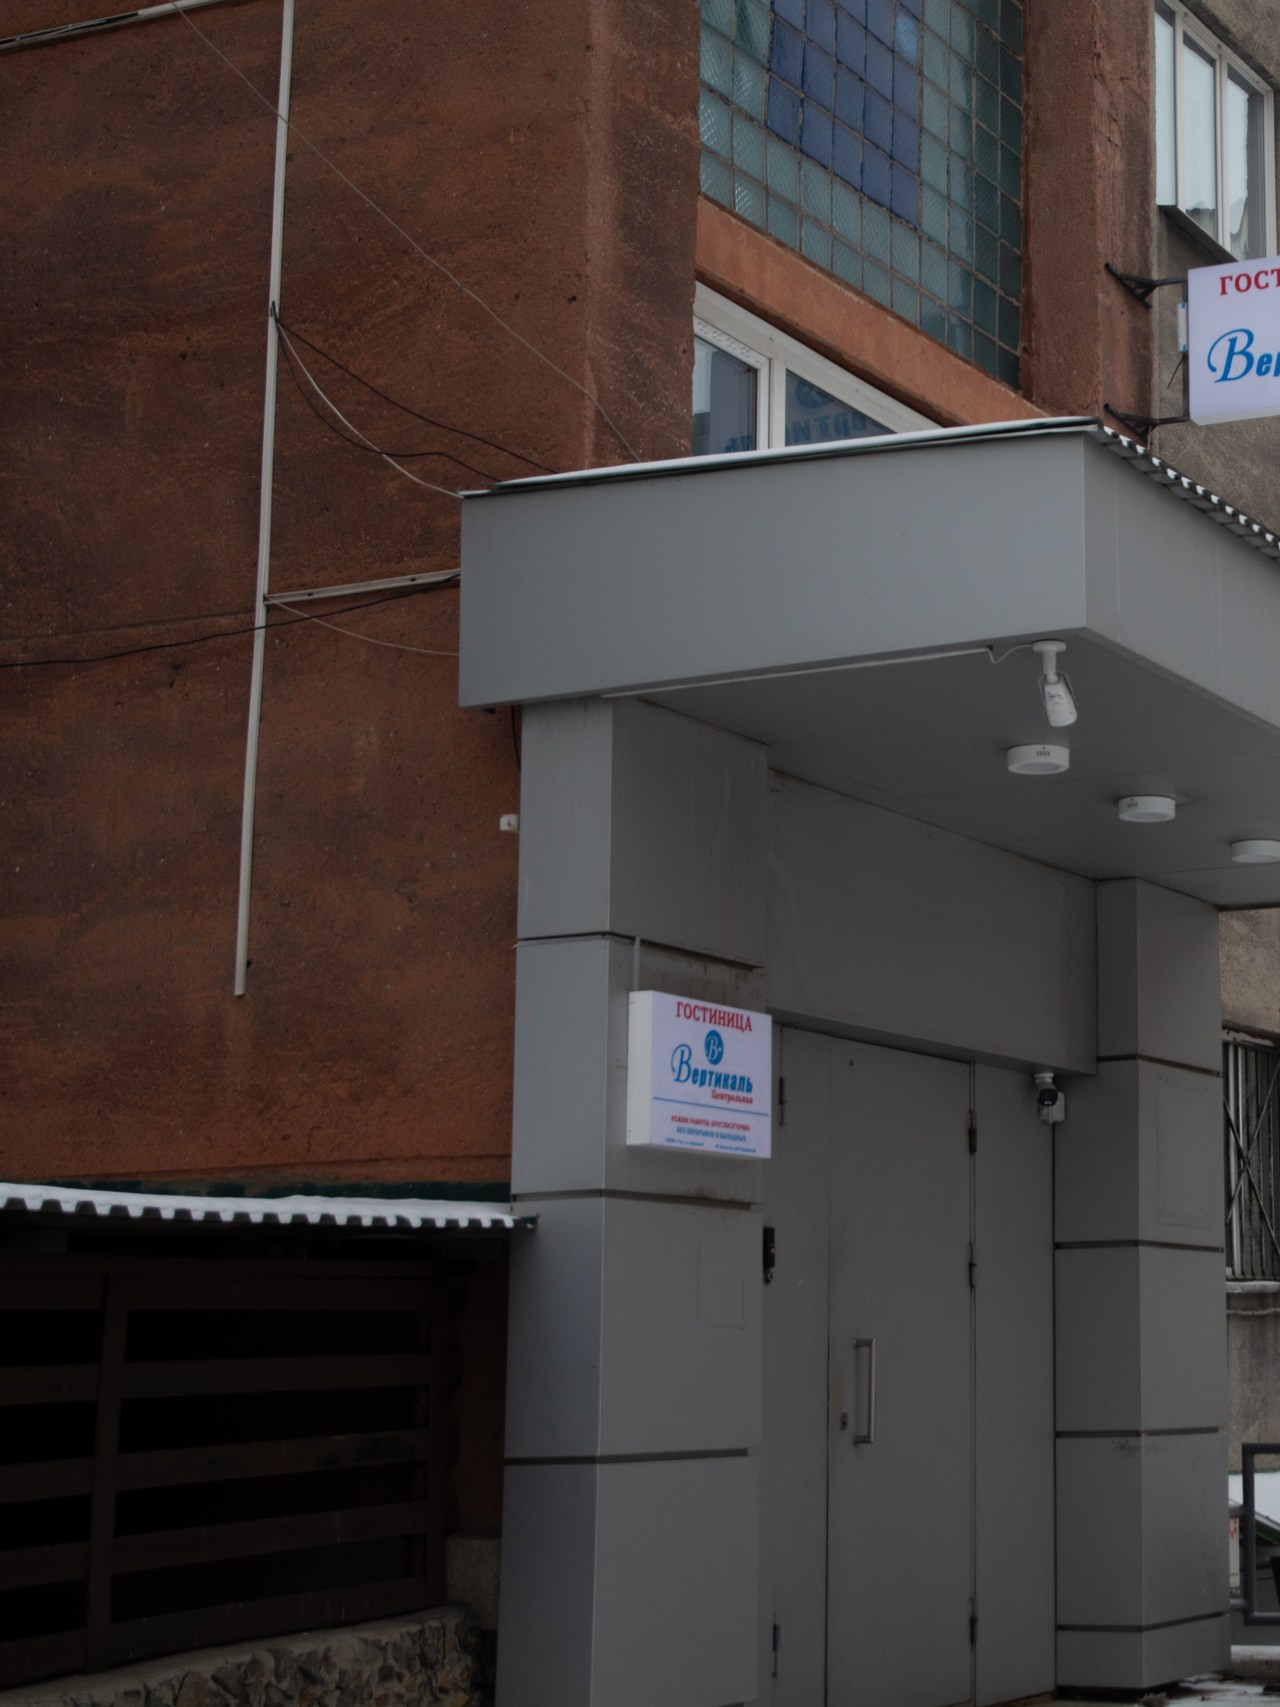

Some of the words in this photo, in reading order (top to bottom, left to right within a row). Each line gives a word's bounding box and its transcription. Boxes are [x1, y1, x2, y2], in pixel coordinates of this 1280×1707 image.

[675, 1001, 753, 1032] ГОСТИНИЦА
[671, 1043, 753, 1093] Вертикаль
[711, 1089, 753, 1105] Центральная
